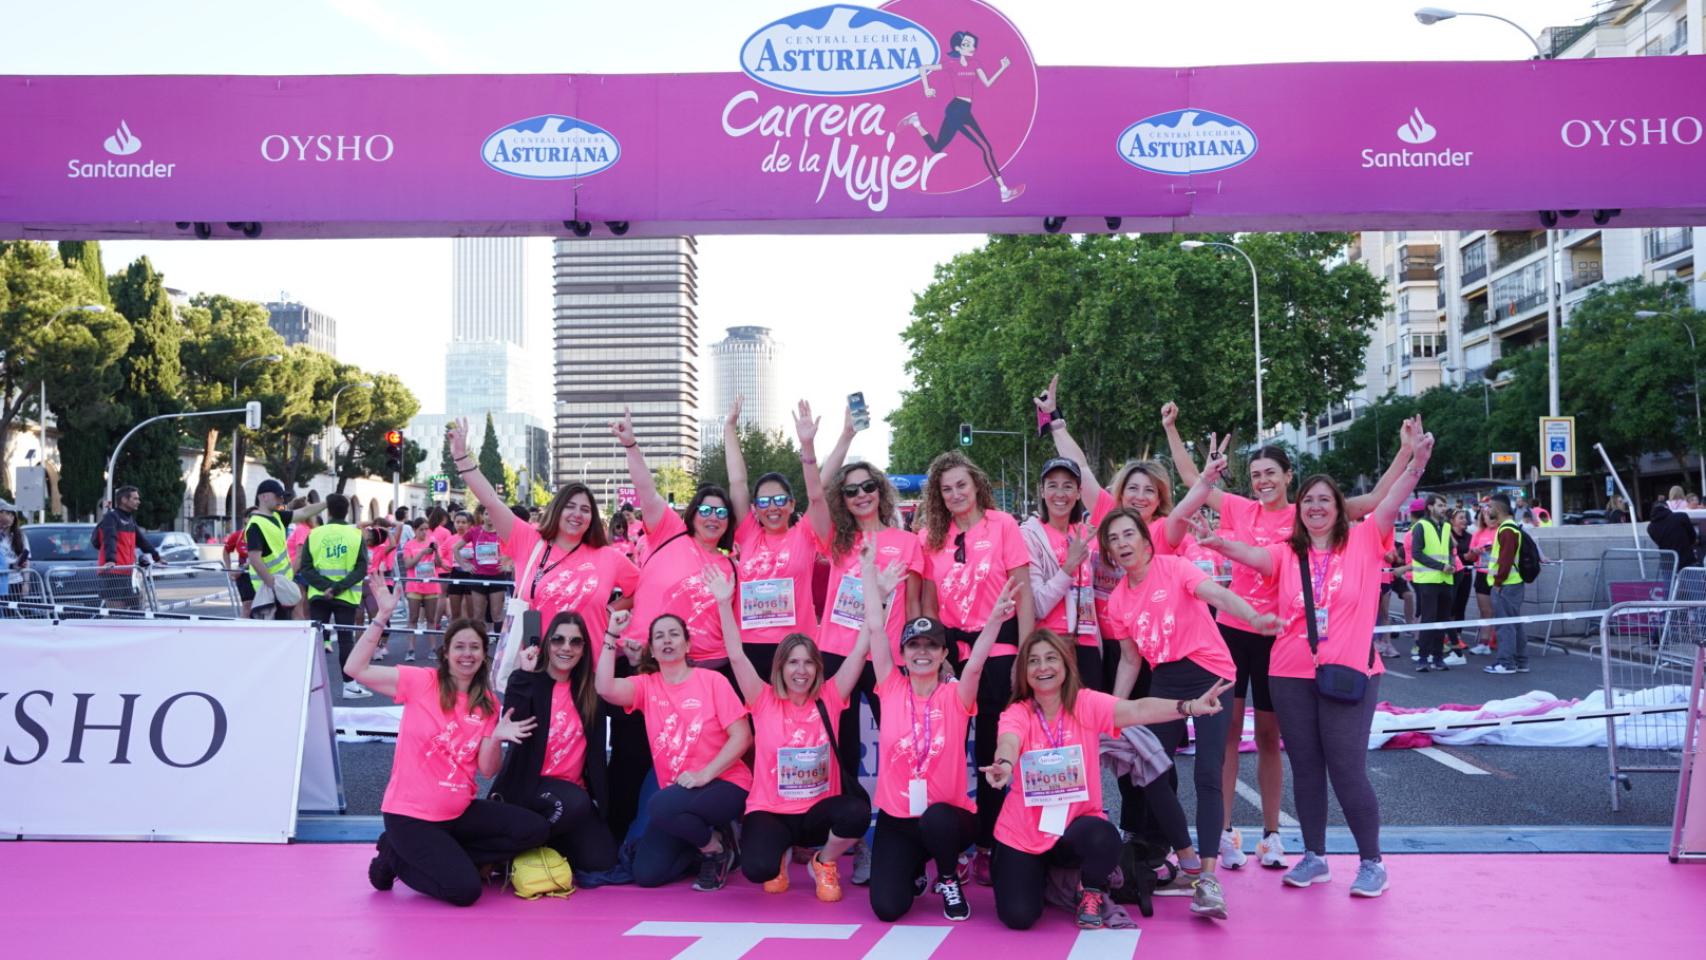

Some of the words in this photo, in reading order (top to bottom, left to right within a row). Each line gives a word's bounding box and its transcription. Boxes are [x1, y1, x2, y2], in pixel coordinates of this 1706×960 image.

[784, 35, 848, 45] CENTRAL
[854, 33, 918, 43] LECHERA
[755, 38, 922, 72] ASTURIANA
[722, 90, 886, 138] Carrera
[513, 136, 557, 144] CENTRAL
[1149, 131, 1194, 139] CENTRAL
[1196, 130, 1242, 138] LECHERA
[1561, 116, 1703, 148] OYSHO
[261, 134, 394, 162] OYSHO
[492, 138, 609, 163] ASTURIANA
[1128, 132, 1247, 158] ASTURIANA
[1361, 148, 1473, 168] Santander
[67, 159, 176, 178] Santander
[761, 140, 792, 173] de
[799, 139, 820, 173] la
[815, 131, 948, 212] Mujer
[326, 543, 348, 558] Life
[757, 600, 778, 609] 016
[0, 689, 228, 768] SHO
[797, 769, 818, 778] 016
[1042, 773, 1066, 784] 016
